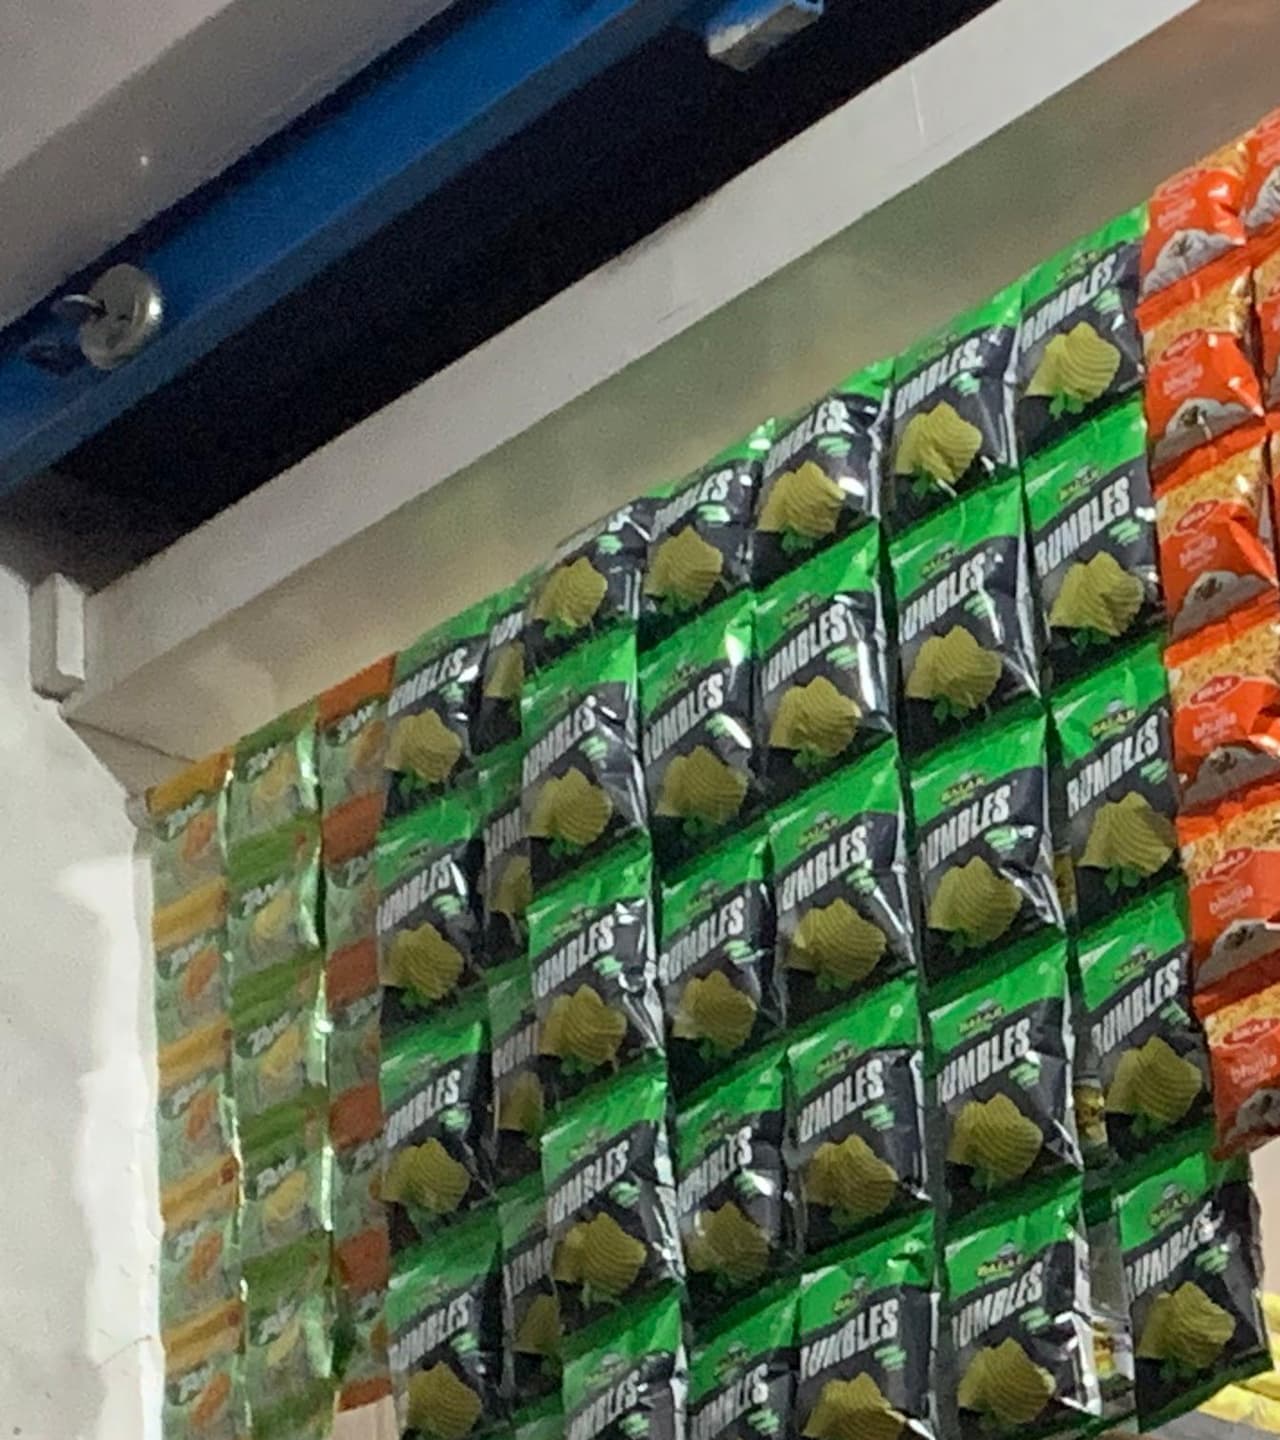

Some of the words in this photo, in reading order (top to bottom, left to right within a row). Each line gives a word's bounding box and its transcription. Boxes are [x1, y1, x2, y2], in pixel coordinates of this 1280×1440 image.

[893, 336, 983, 421] UMBLES
[1034, 477, 1130, 580] RUMBLES
[899, 552, 986, 643] UMBLES
[388, 648, 468, 716] UMBLES
[761, 604, 847, 694] UMBLES
[523, 703, 595, 788] UMBLES
[643, 674, 724, 766] UMBLES
[1067, 714, 1159, 816] RUMBLES
[777, 825, 867, 909] UMBLES
[920, 785, 1010, 880] UMBLES
[378, 853, 451, 934] UMBLES
[532, 914, 615, 998] UMBLES
[800, 1059, 884, 1142] UMBLES
[937, 1018, 1030, 1101] UMBLES
[384, 1069, 461, 1150] UMBLES
[550, 1142, 629, 1225] UMBLES
[1126, 1200, 1222, 1298] UMBLES
[800, 1299, 898, 1380] UMBLES
[952, 1262, 1042, 1348] UMBLES
